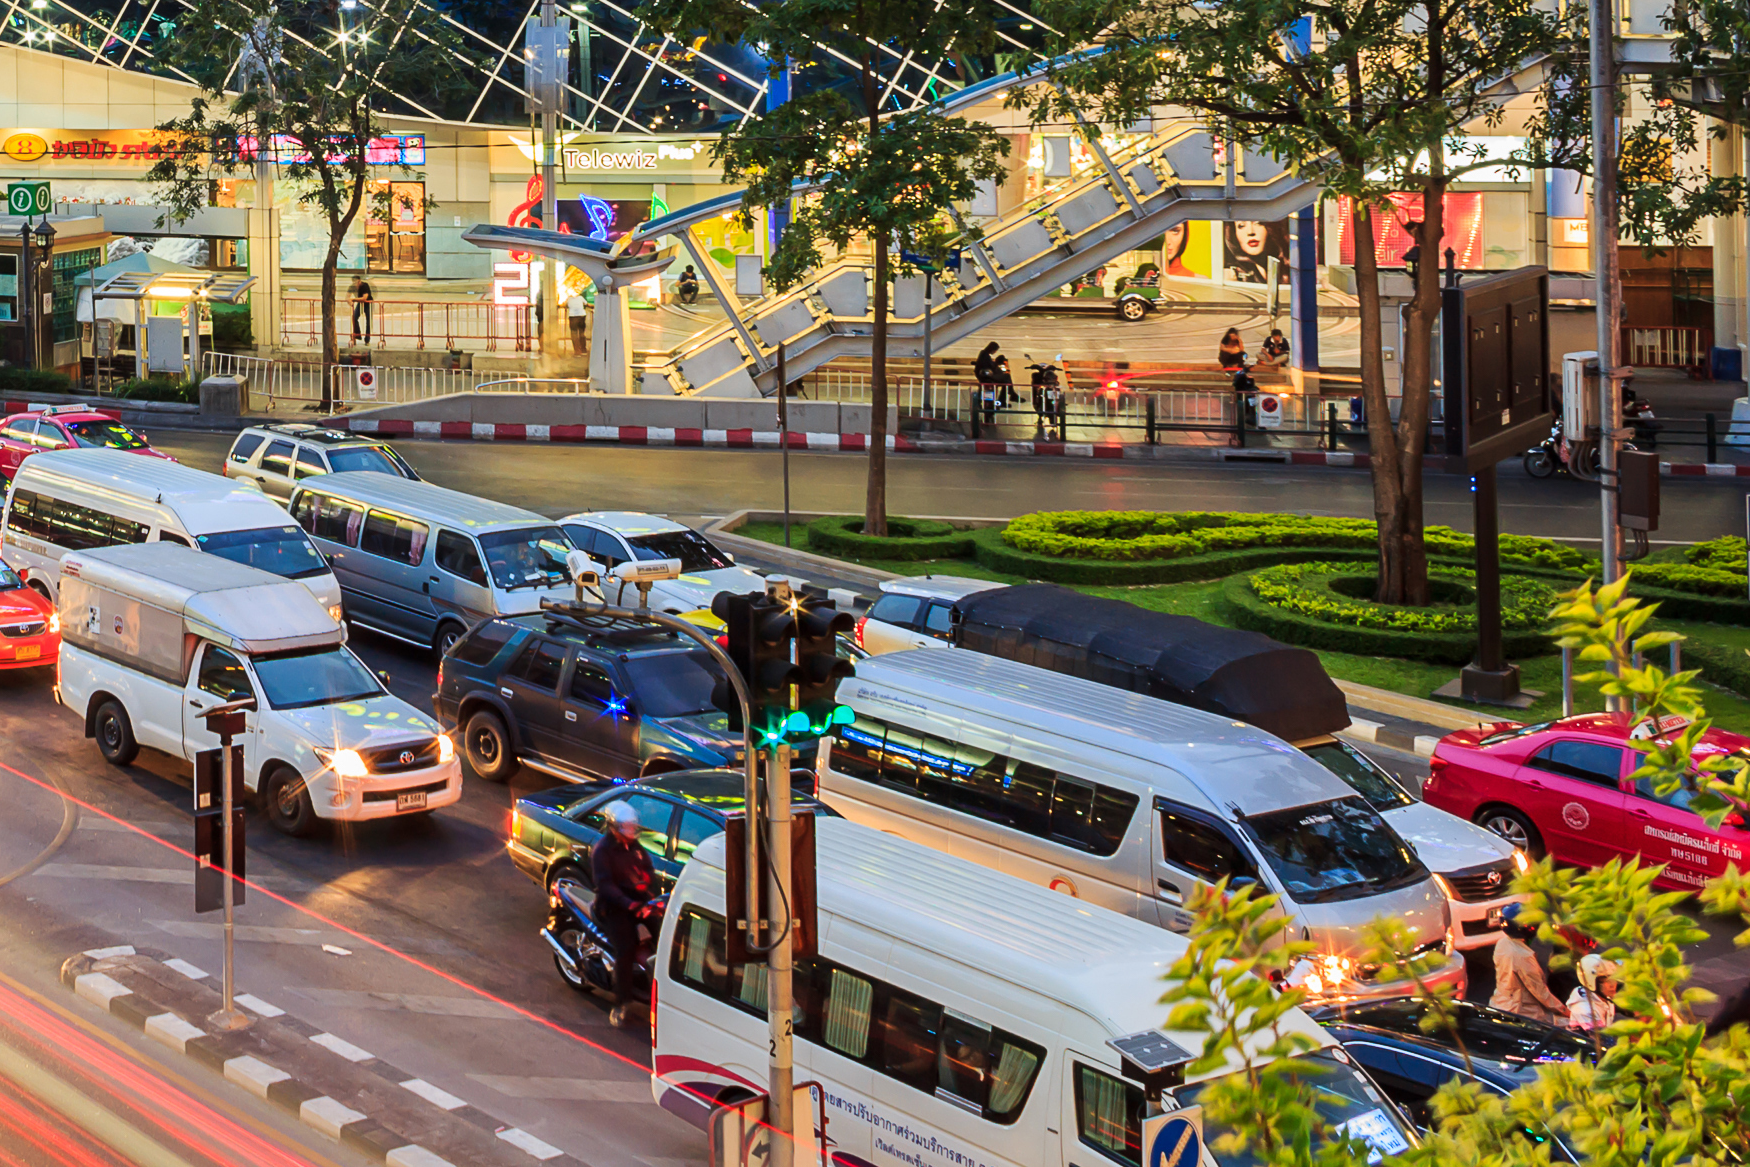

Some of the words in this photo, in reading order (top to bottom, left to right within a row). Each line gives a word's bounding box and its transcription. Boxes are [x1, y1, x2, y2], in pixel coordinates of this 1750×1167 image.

[564, 147, 658, 170] Telewiz
[785, 1018, 792, 1036] 2
[769, 1038, 776, 1057] 2
